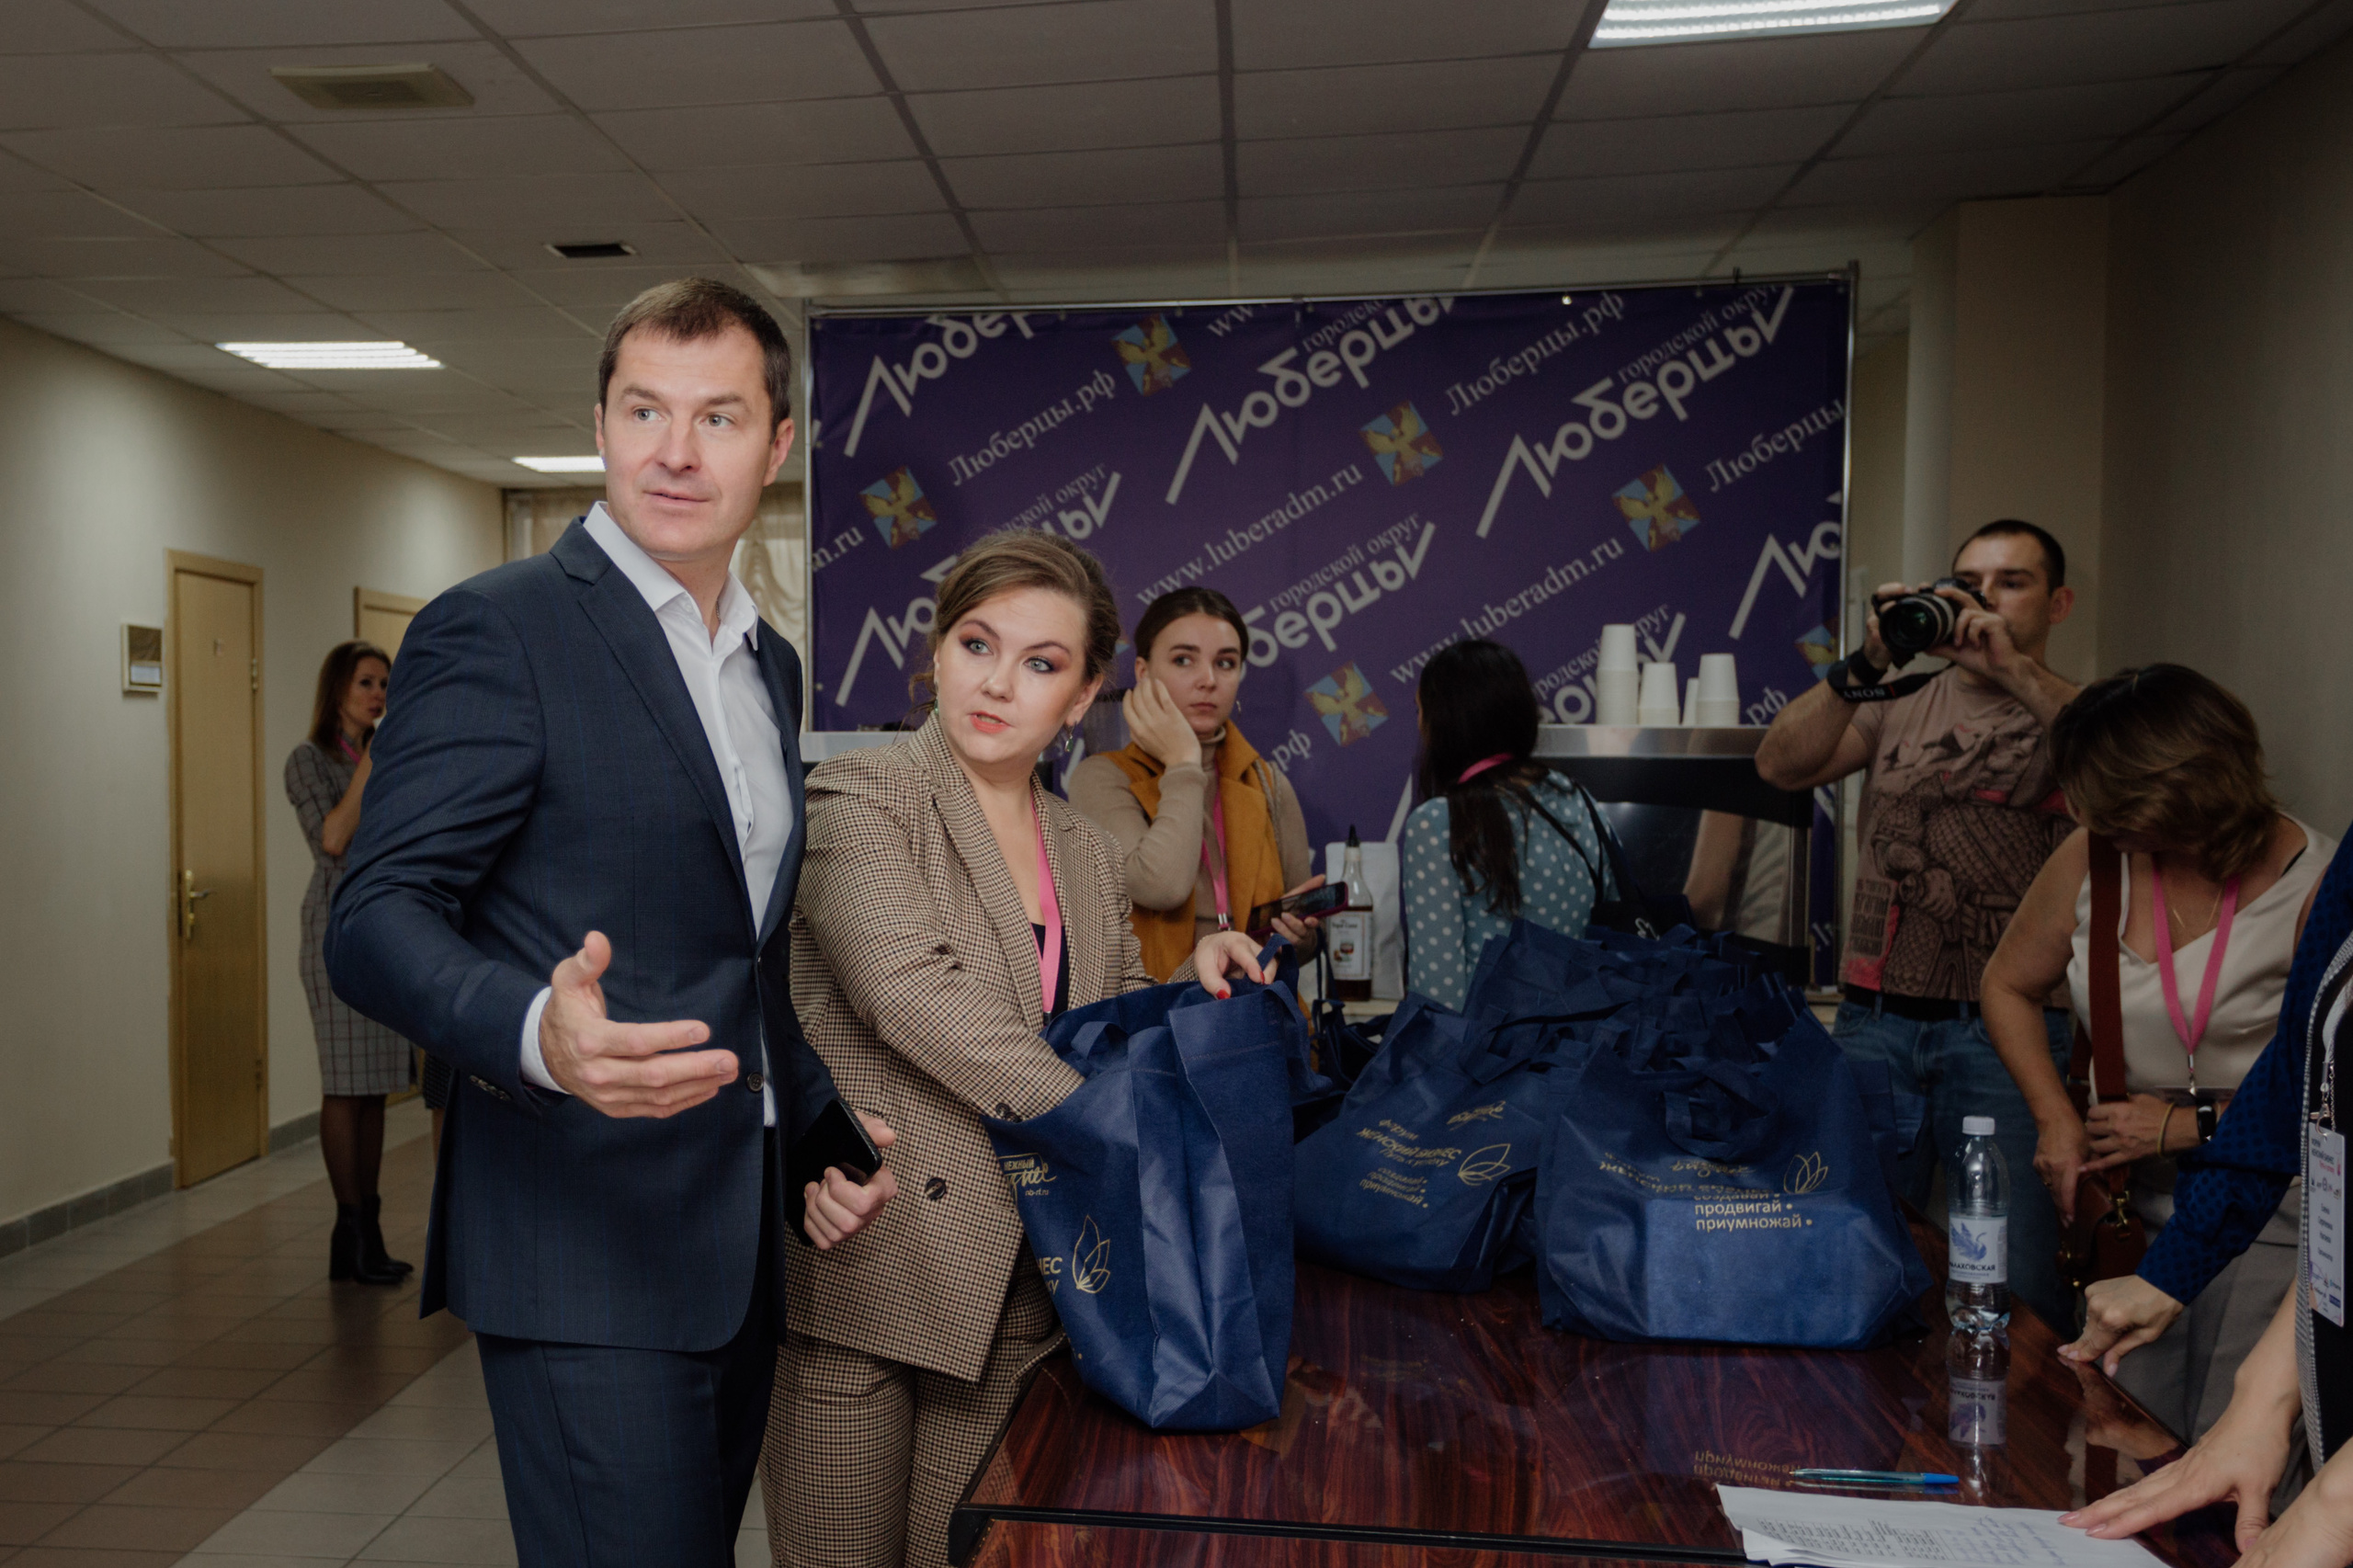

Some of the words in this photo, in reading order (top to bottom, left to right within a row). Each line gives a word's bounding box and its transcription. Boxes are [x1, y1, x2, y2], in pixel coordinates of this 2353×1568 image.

[1302, 301, 1386, 352] городск
[1444, 290, 1624, 416] Люберцы.рф
[1617, 311, 1719, 384] городской
[948, 369, 1117, 486] Люберцы.рф
[1475, 285, 1794, 539] Люберцы
[1703, 398, 1844, 493] Люберцы
[1054, 462, 1106, 504] округ
[1136, 463, 1363, 606] www.luberadm.ru
[1269, 544, 1365, 613] городской
[1367, 513, 1421, 555] округ
[1241, 522, 1436, 681] берцы
[1695, 1199, 1781, 1216] продвигай
[1696, 1214, 1802, 1233] приумножай
